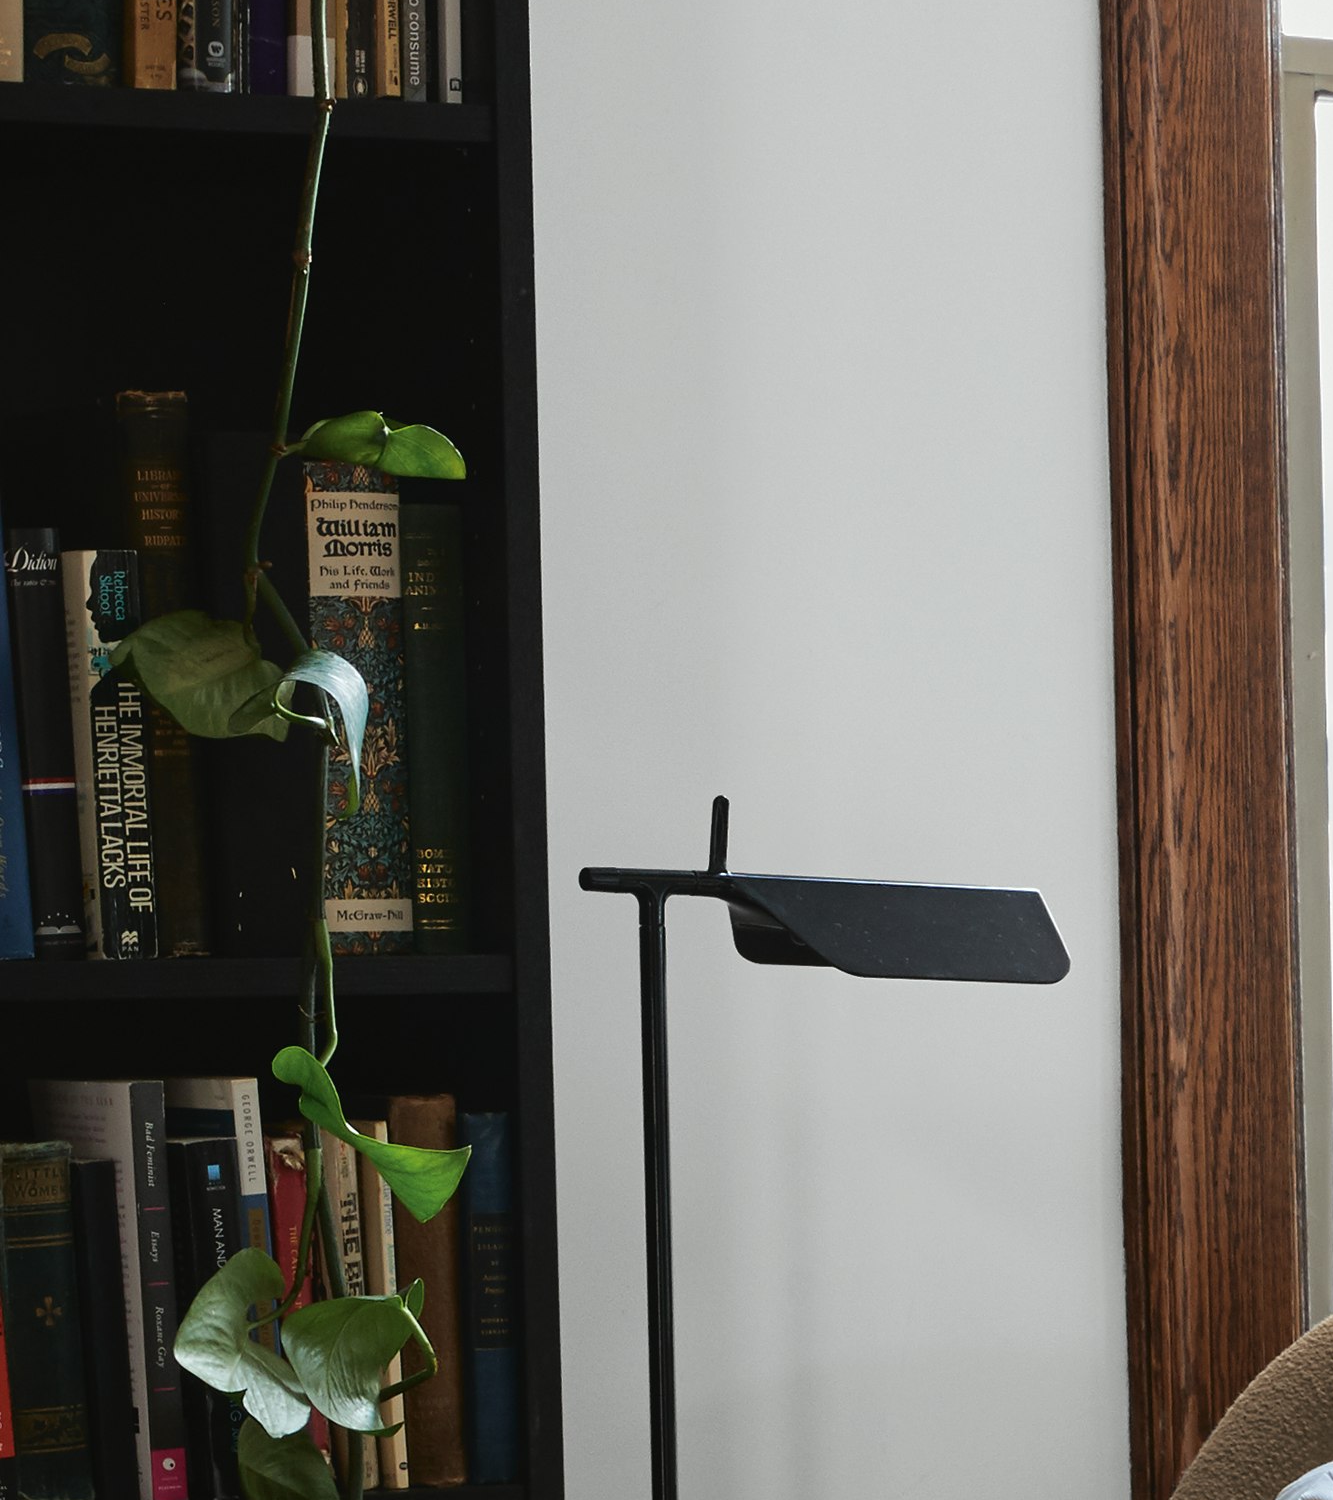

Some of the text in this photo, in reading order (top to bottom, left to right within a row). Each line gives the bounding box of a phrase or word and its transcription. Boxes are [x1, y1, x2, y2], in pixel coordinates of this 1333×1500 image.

[408, 10, 421, 88] consume
[310, 499, 348, 512] Philip
[315, 516, 397, 539] William
[6, 545, 59, 573] Didion
[322, 538, 393, 558] Morris
[369, 565, 396, 578] Work
[112, 568, 129, 621] Rebecca
[329, 579, 350, 590] and
[93, 704, 127, 890] HENRIETTA LACKS
[117, 722, 149, 837] IMMORTAL
[125, 840, 152, 884] LIFE
[127, 886, 154, 914] OF
[143, 1120, 157, 1188] Bad Feminist
[240, 1093, 257, 1183] GEORGE ORWELL
[149, 1230, 163, 1264] Essays
[211, 1206, 228, 1270] MAN AND
[339, 1191, 361, 1257] THE
[154, 1305, 169, 1369] Roxane Gay
